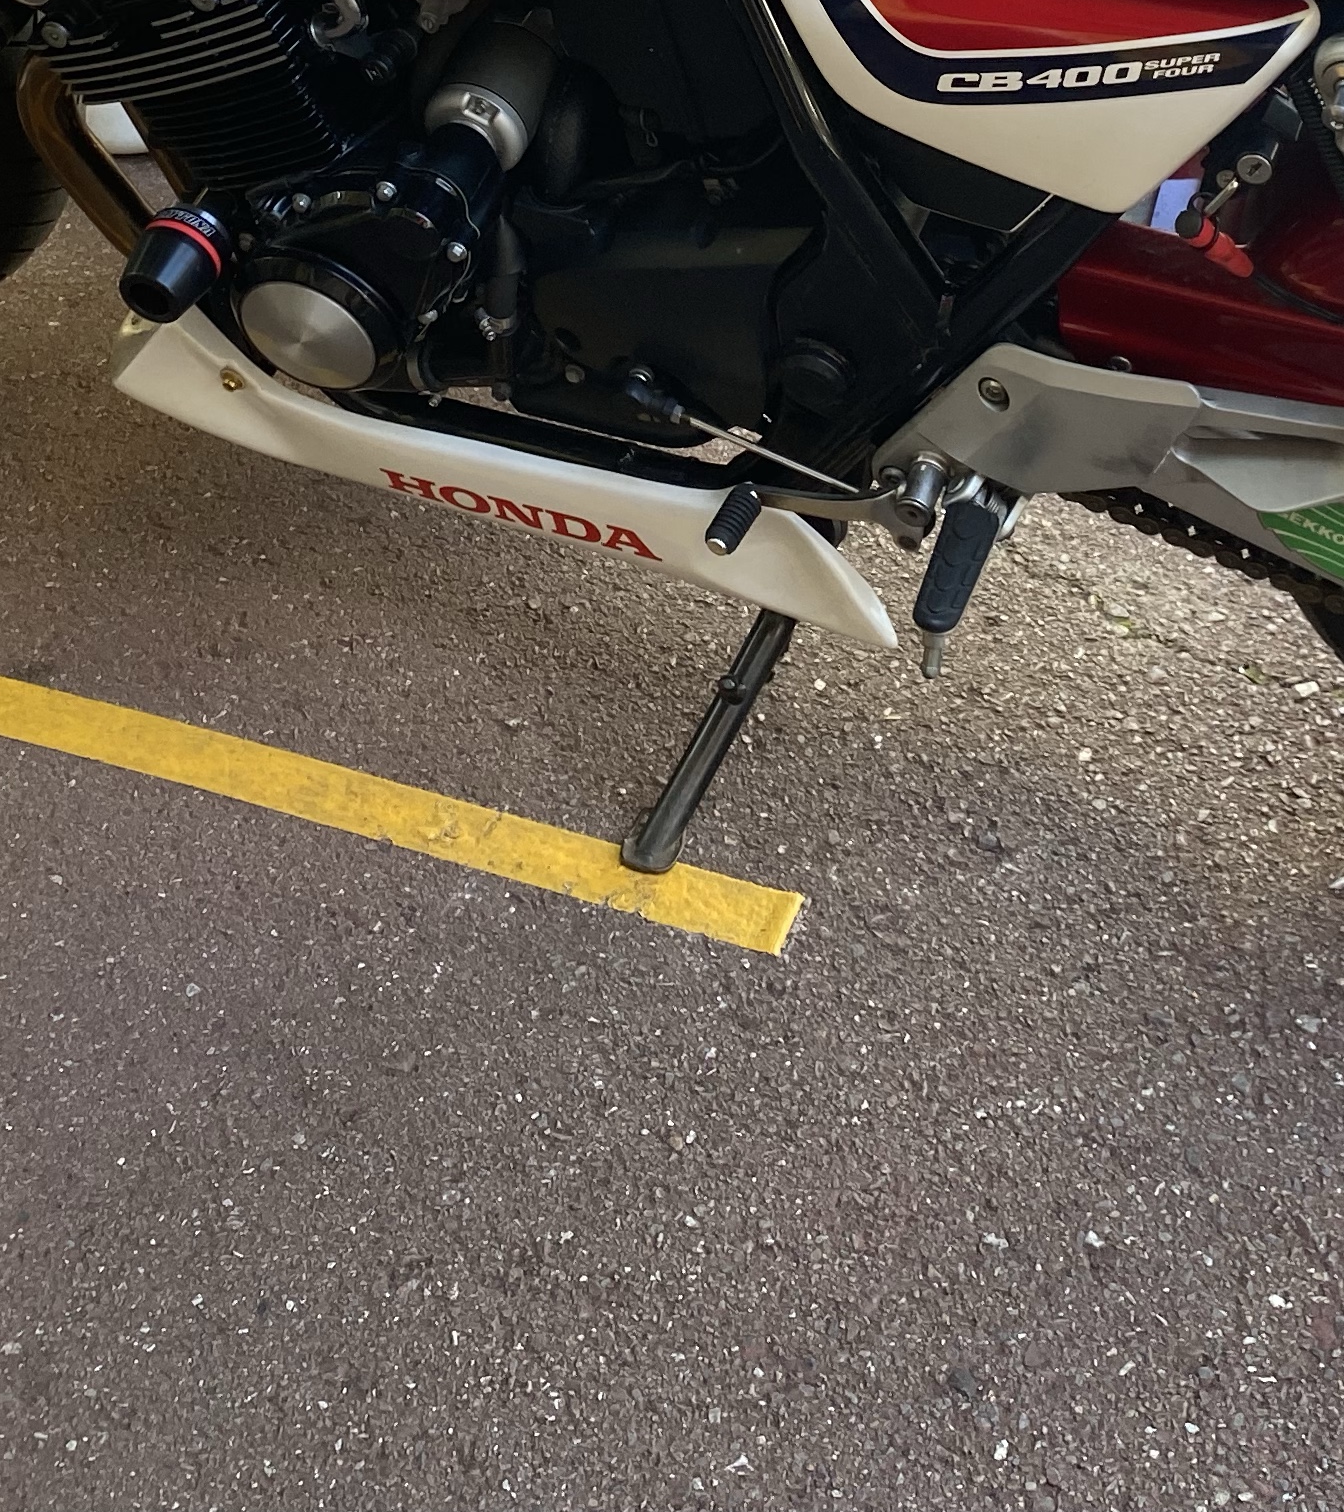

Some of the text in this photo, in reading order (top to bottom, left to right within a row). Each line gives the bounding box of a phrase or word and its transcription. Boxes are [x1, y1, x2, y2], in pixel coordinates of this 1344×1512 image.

[936, 52, 1221, 94] CB400 SUPER
[1151, 63, 1215, 80] FOUR
[379, 467, 663, 562] HONDA
